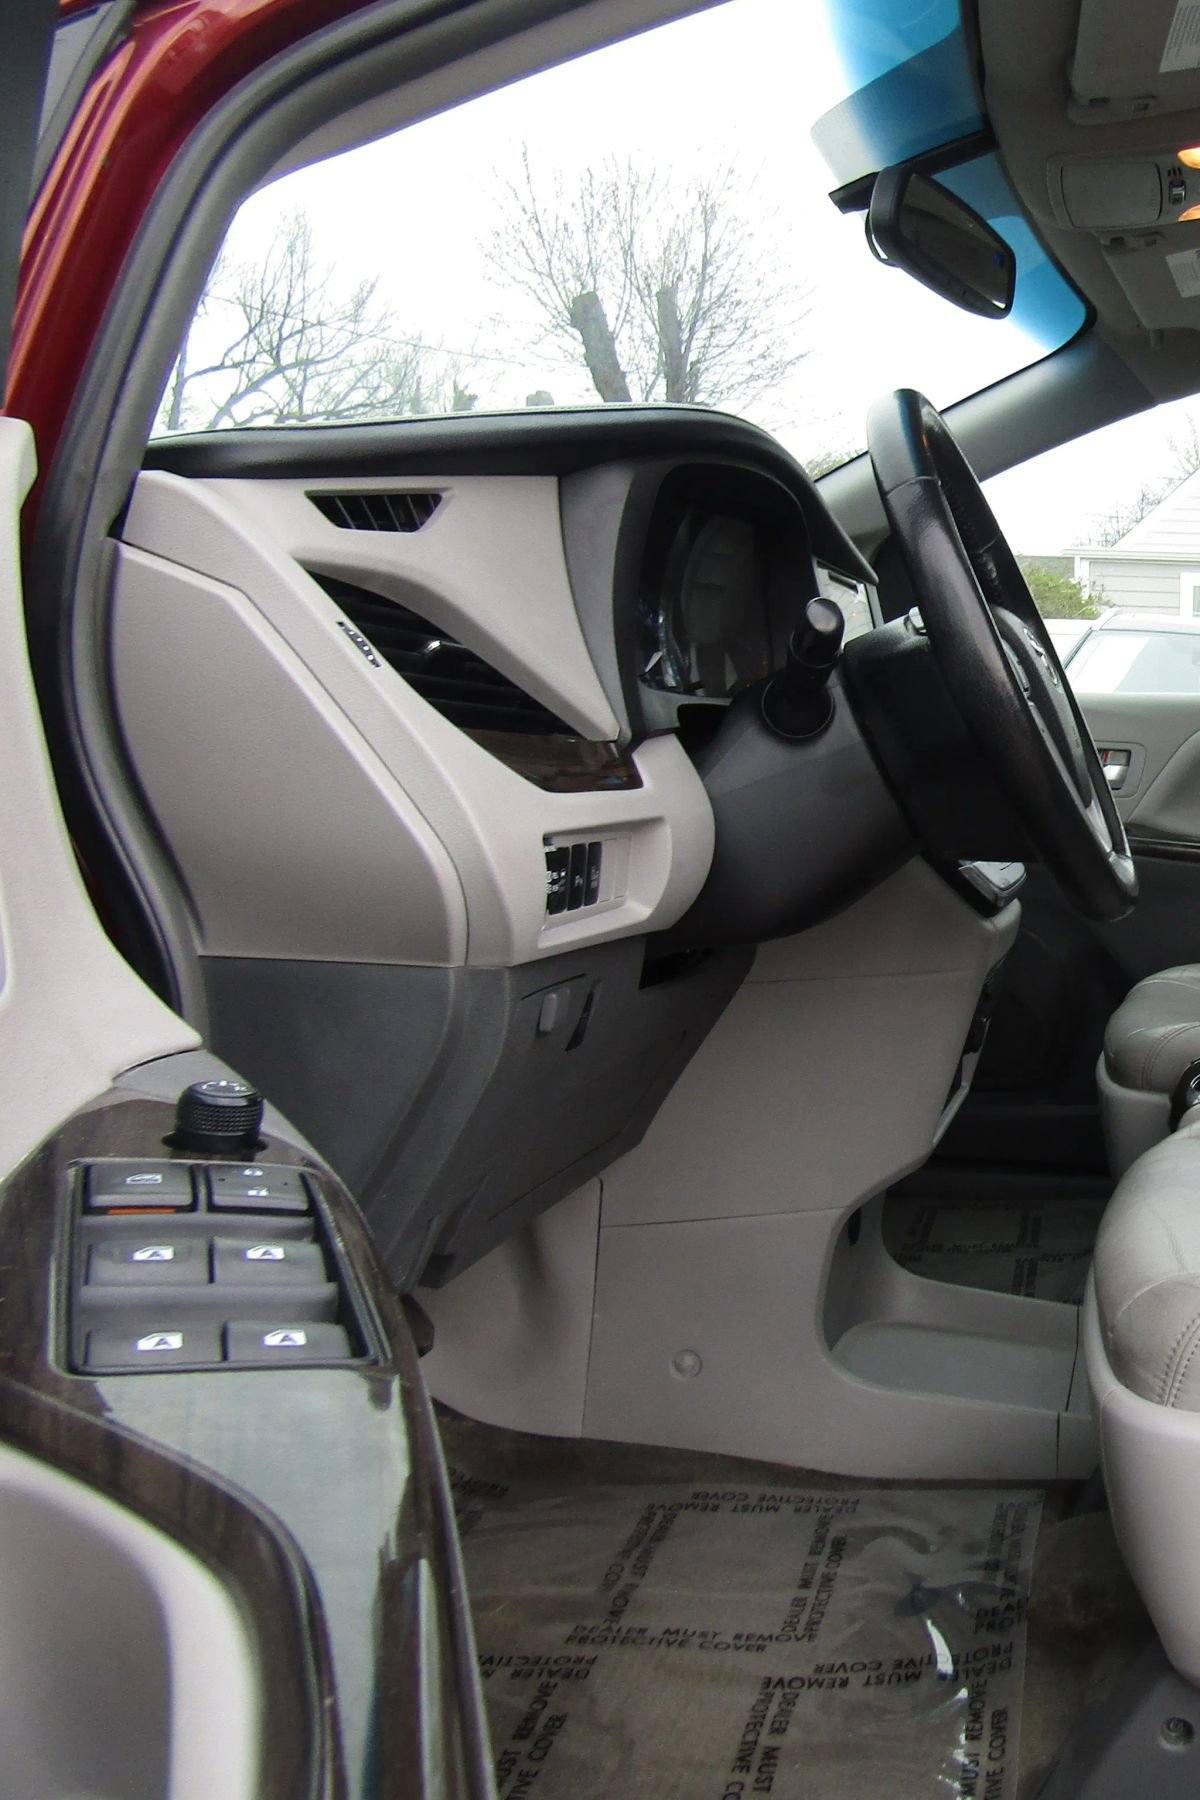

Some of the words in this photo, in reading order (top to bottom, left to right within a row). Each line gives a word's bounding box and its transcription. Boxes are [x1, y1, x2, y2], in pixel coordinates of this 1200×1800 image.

[691, 1491, 749, 1501] COVER
[730, 1503, 781, 1512] MUST
[572, 1624, 648, 1635] DEALER
[663, 1627, 721, 1639] MUST
[733, 1632, 818, 1643] REMOVE
[565, 1634, 692, 1648] PROTECTIVE
[699, 1641, 767, 1653] COVER
[479, 1655, 598, 1667] PROTECTIV
[893, 1642, 1013, 1670] PROTETIVE
[510, 1668, 591, 1680] DEALER
[814, 1661, 882, 1674] COVER
[761, 1676, 849, 1690] REMOVE
[862, 1671, 922, 1688] MUST
[965, 1680, 987, 1740] REMOVE
[988, 1706, 1008, 1760] COVER
[752, 1746, 781, 1792] MUST
